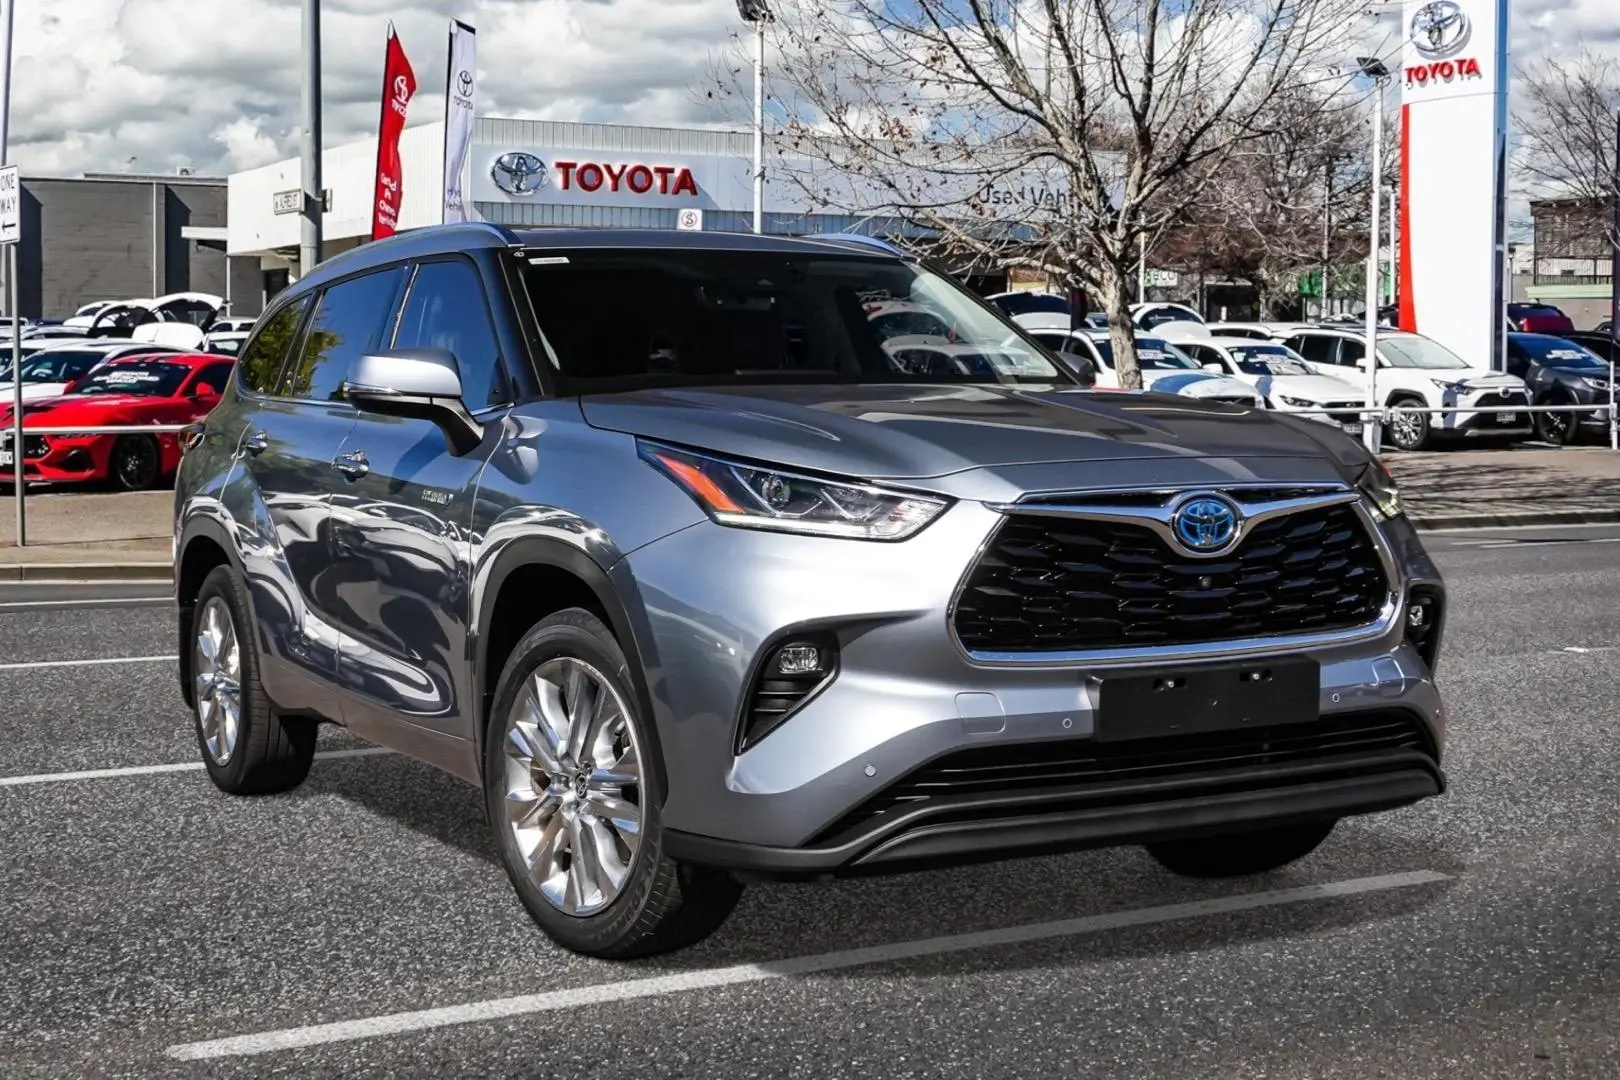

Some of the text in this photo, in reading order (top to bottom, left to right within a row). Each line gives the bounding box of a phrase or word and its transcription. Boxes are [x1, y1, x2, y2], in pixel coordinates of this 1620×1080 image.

[1404, 58, 1481, 83] TOYOTA
[0, 172, 16, 192] ONE
[555, 161, 698, 196] TOYOTA
[0, 196, 17, 214] WAY
